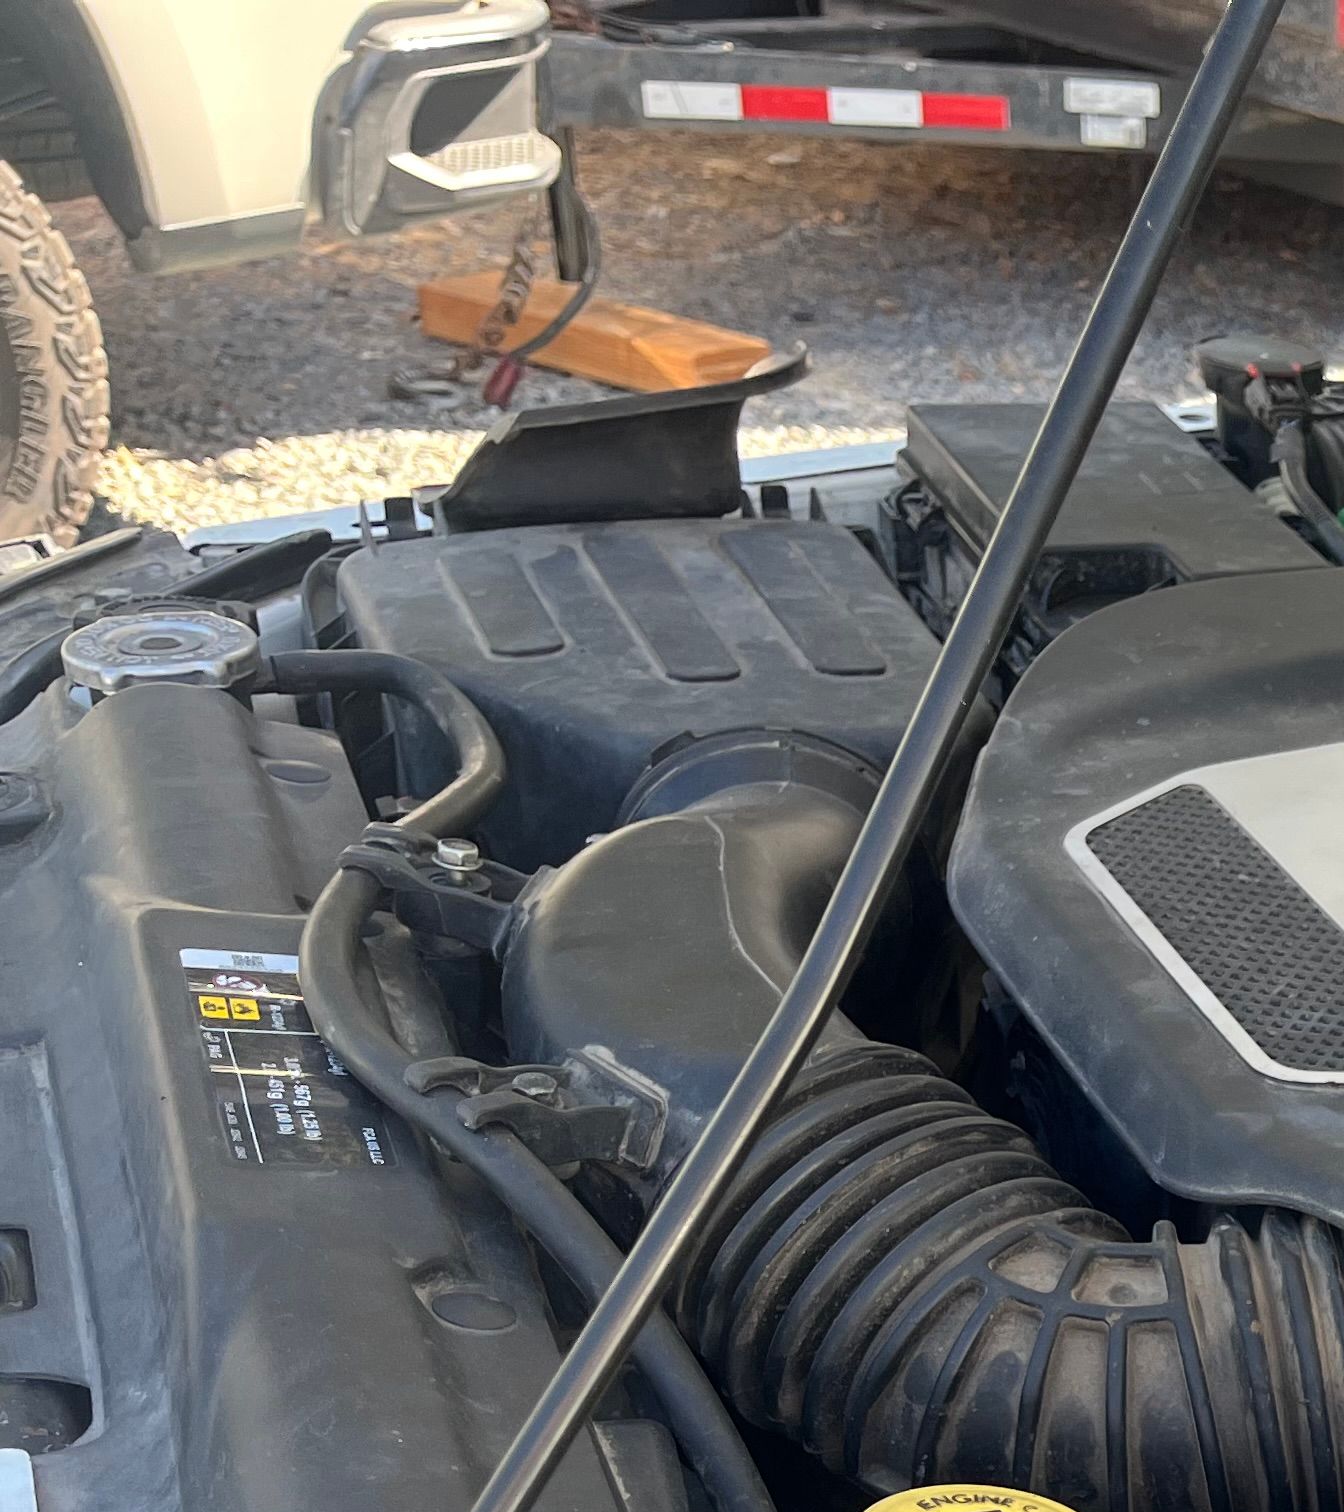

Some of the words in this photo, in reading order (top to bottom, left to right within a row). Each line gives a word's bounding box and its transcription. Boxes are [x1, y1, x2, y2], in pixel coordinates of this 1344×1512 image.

[363, 1127, 375, 1142] FCA
[370, 1151, 384, 1165] LLC
[916, 1493, 1015, 1511] ENGINE
